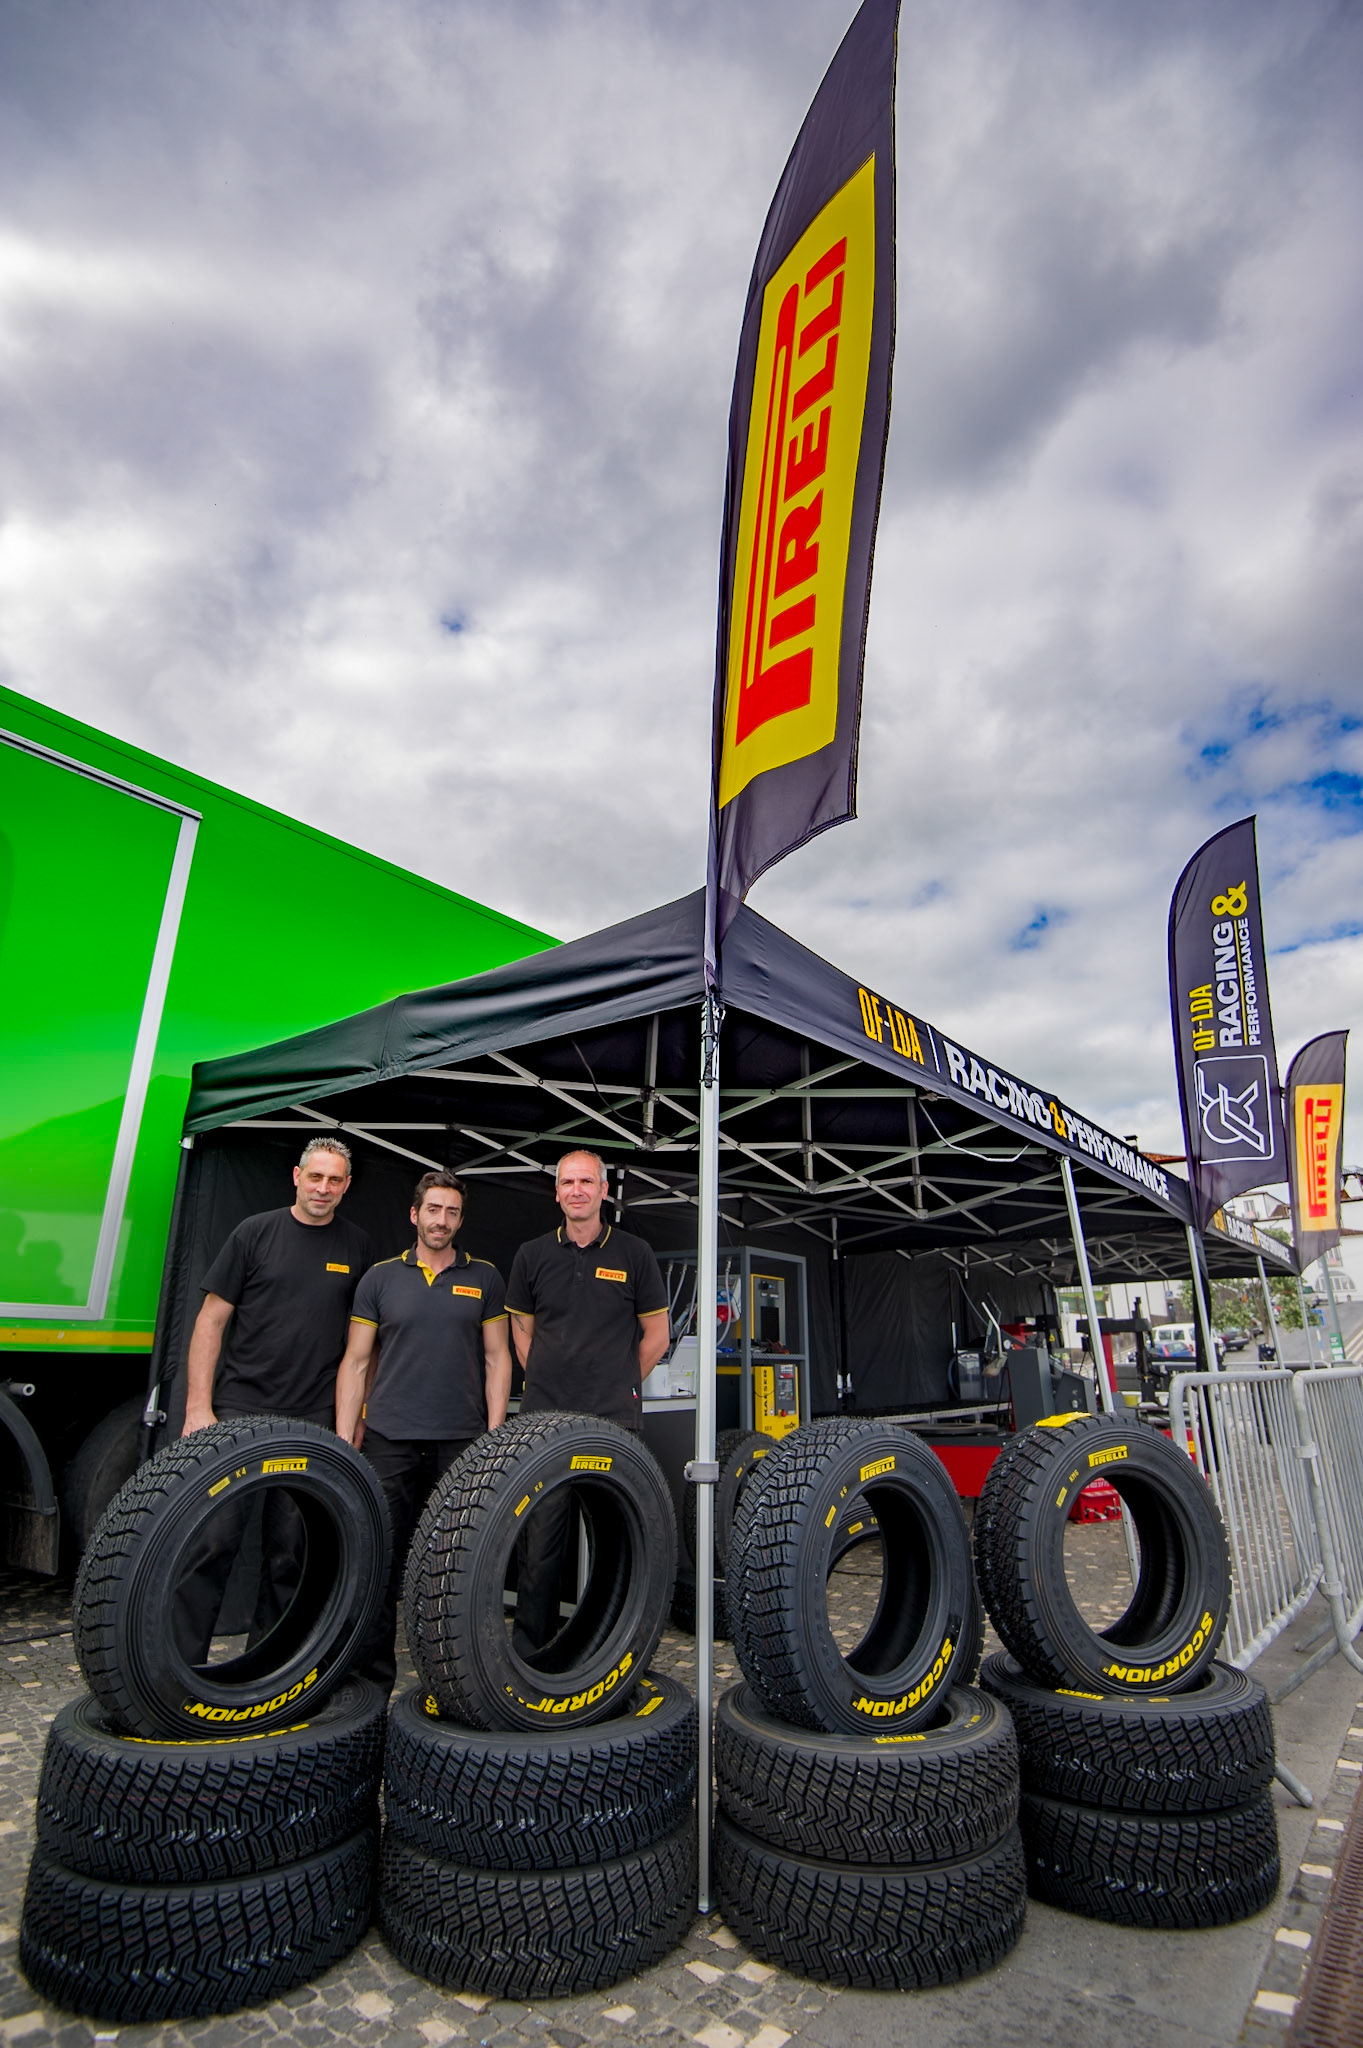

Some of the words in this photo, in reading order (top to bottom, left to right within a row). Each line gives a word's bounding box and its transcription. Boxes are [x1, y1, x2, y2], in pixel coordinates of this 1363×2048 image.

[735, 236, 848, 748] PIRELLI
[1211, 880, 1248, 917] &
[1212, 920, 1243, 1048] RACING
[1238, 917, 1262, 1047] PERFORMANCE
[943, 1039, 1053, 1130] RACING
[1049, 1101, 1067, 1139] &
[1063, 1108, 1170, 1201] PERFORMANCE
[1304, 1097, 1332, 1218] PIRELLI
[262, 1457, 308, 1474] PIRELLI
[570, 1455, 613, 1471] PIRELLI
[860, 1455, 896, 1482] PIRELLI
[1087, 1445, 1128, 1468] PIRELLI
[856, 1637, 953, 1717] SCORPION
[1107, 1610, 1214, 1683] SCORPION
[188, 1667, 318, 1722] SCORPION
